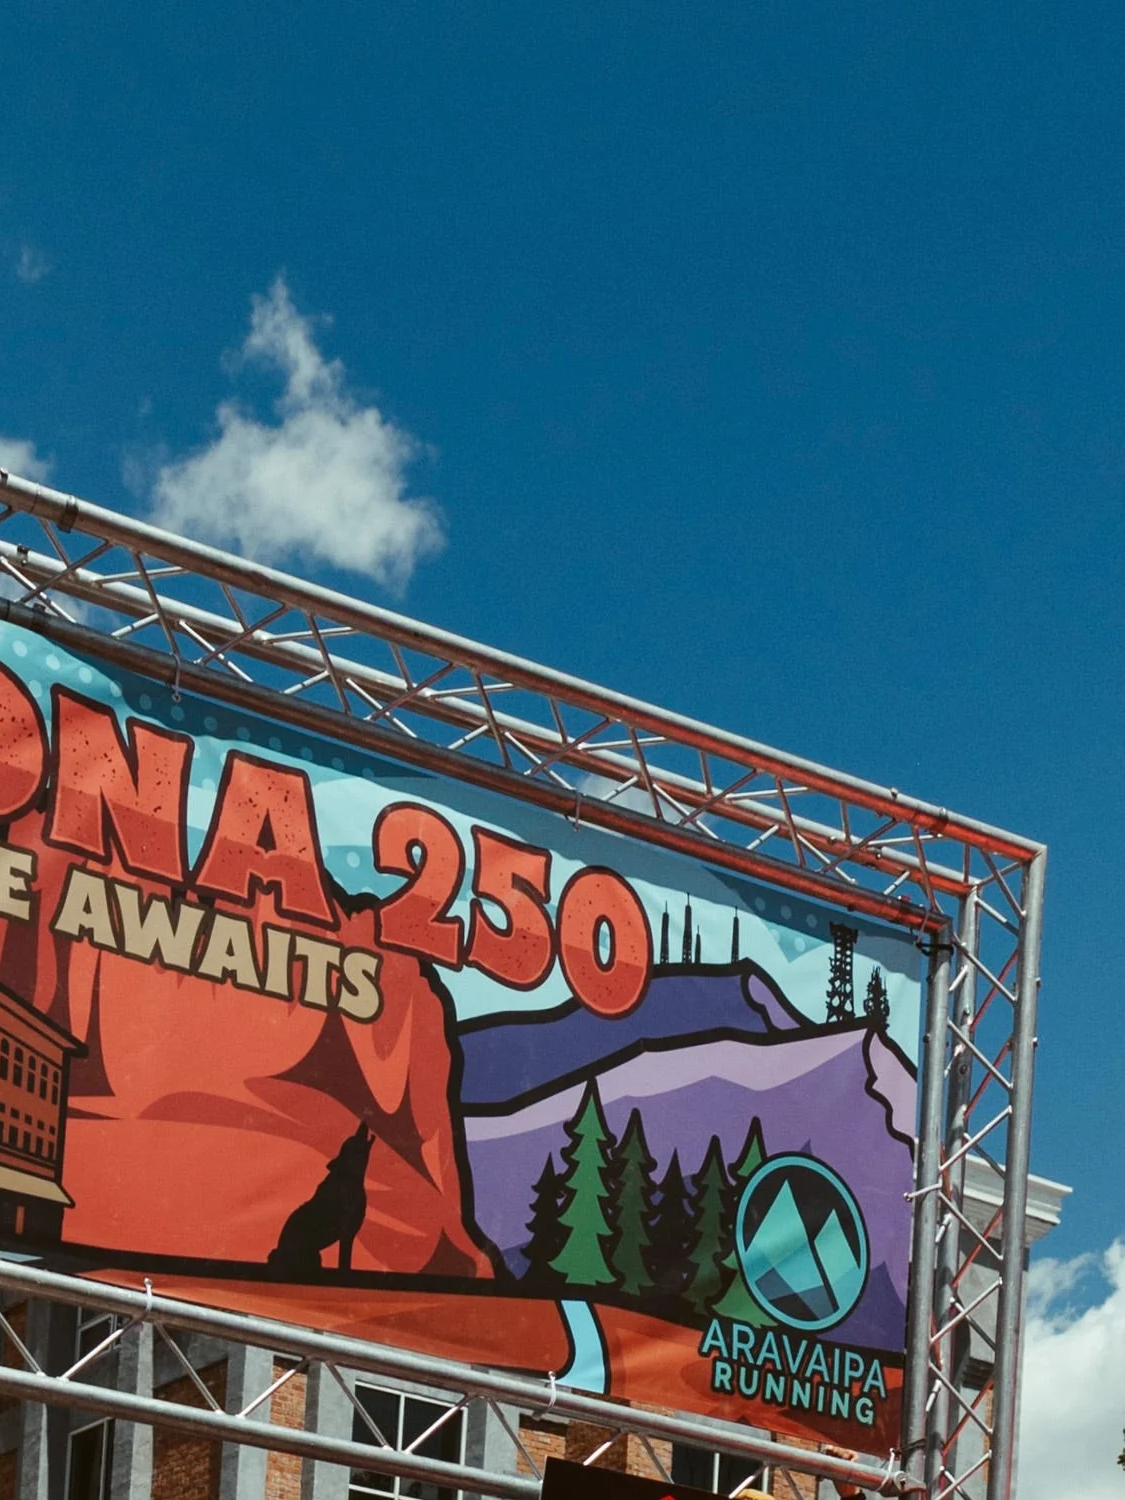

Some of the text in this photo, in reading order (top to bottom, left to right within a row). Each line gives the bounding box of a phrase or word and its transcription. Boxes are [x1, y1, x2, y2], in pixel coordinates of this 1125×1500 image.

[51, 859, 385, 1024] AWAITS
[373, 801, 654, 1019] 250
[701, 1318, 887, 1398] ARAVAIPA
[714, 1361, 874, 1425] RUNNING
